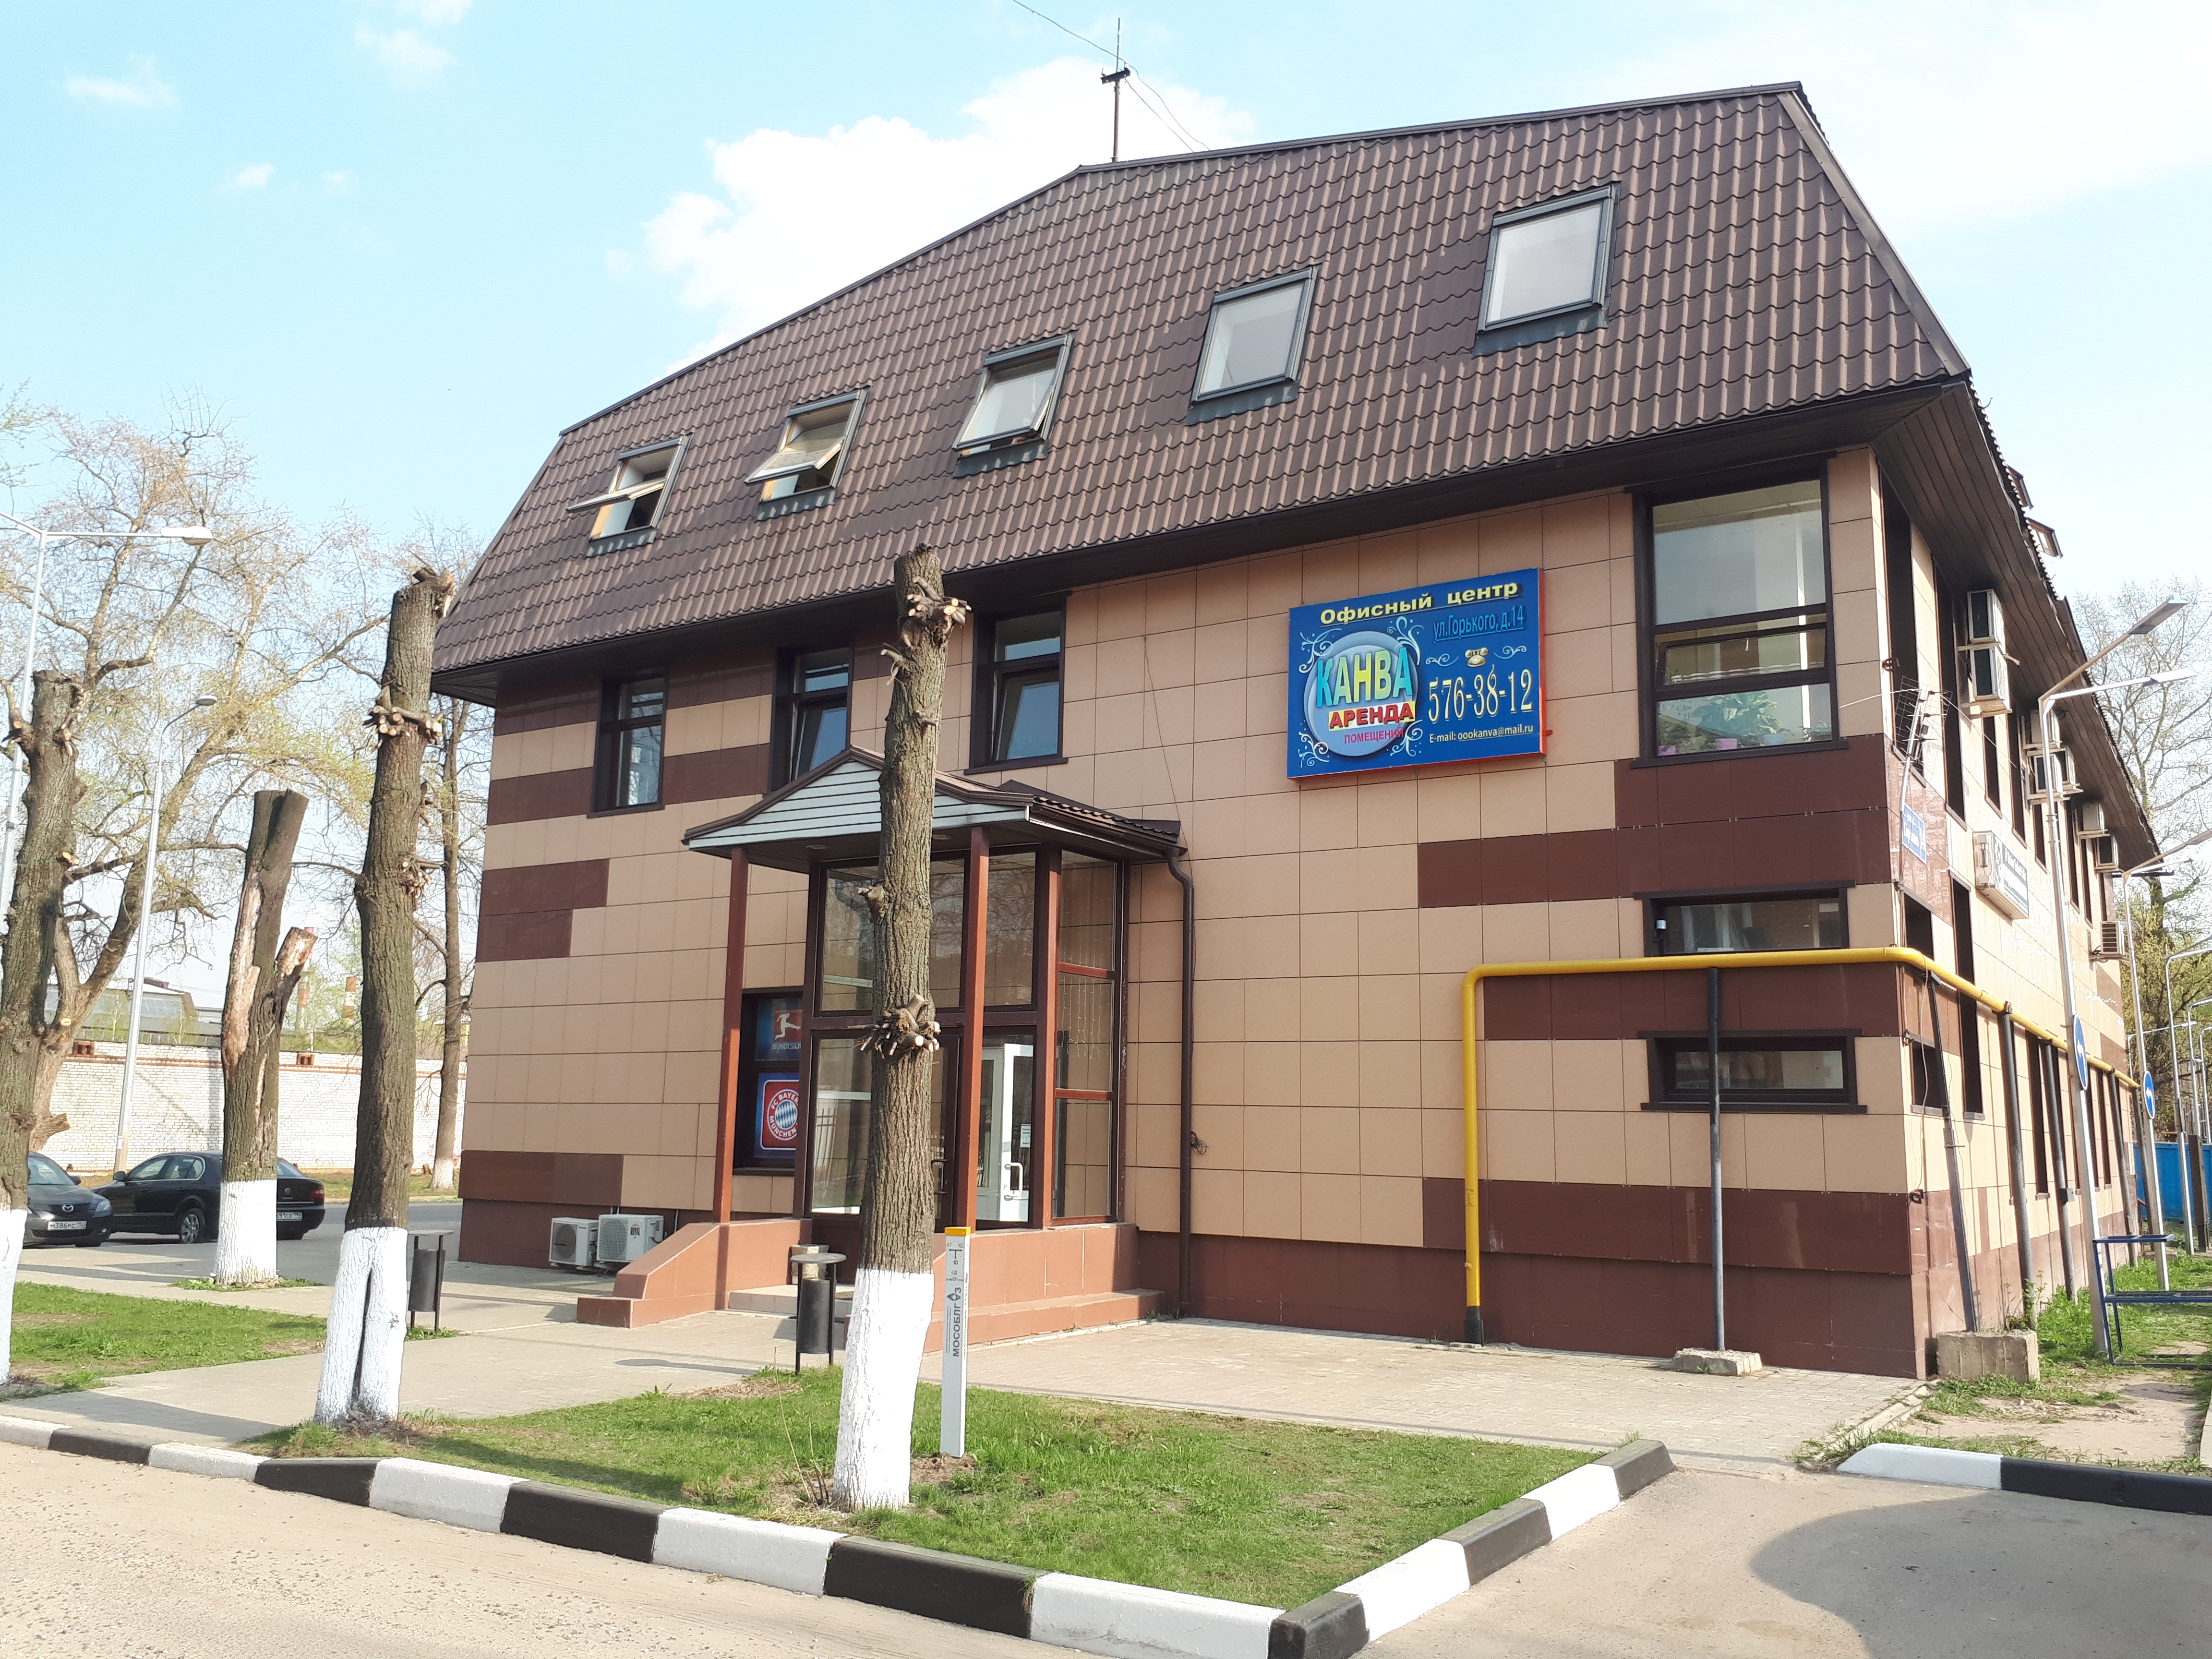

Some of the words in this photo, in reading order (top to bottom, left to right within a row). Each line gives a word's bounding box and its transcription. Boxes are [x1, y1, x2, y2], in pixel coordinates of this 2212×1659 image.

[1321, 593, 1431, 625] Офисный
[1448, 583, 1518, 604] центр
[1317, 647, 1413, 708] КАНВА
[1428, 664, 1533, 724] 576-38-12
[1329, 703, 1414, 729] АРЕНДА
[1345, 727, 1404, 744] ПОМЕЩЕНИЙ
[1429, 731, 1456, 743] E-mail:
[1457, 724, 1533, 740] oookanva@mail.ru
[771, 1099, 779, 1109] FC
[778, 1092, 799, 1106] BAYER
